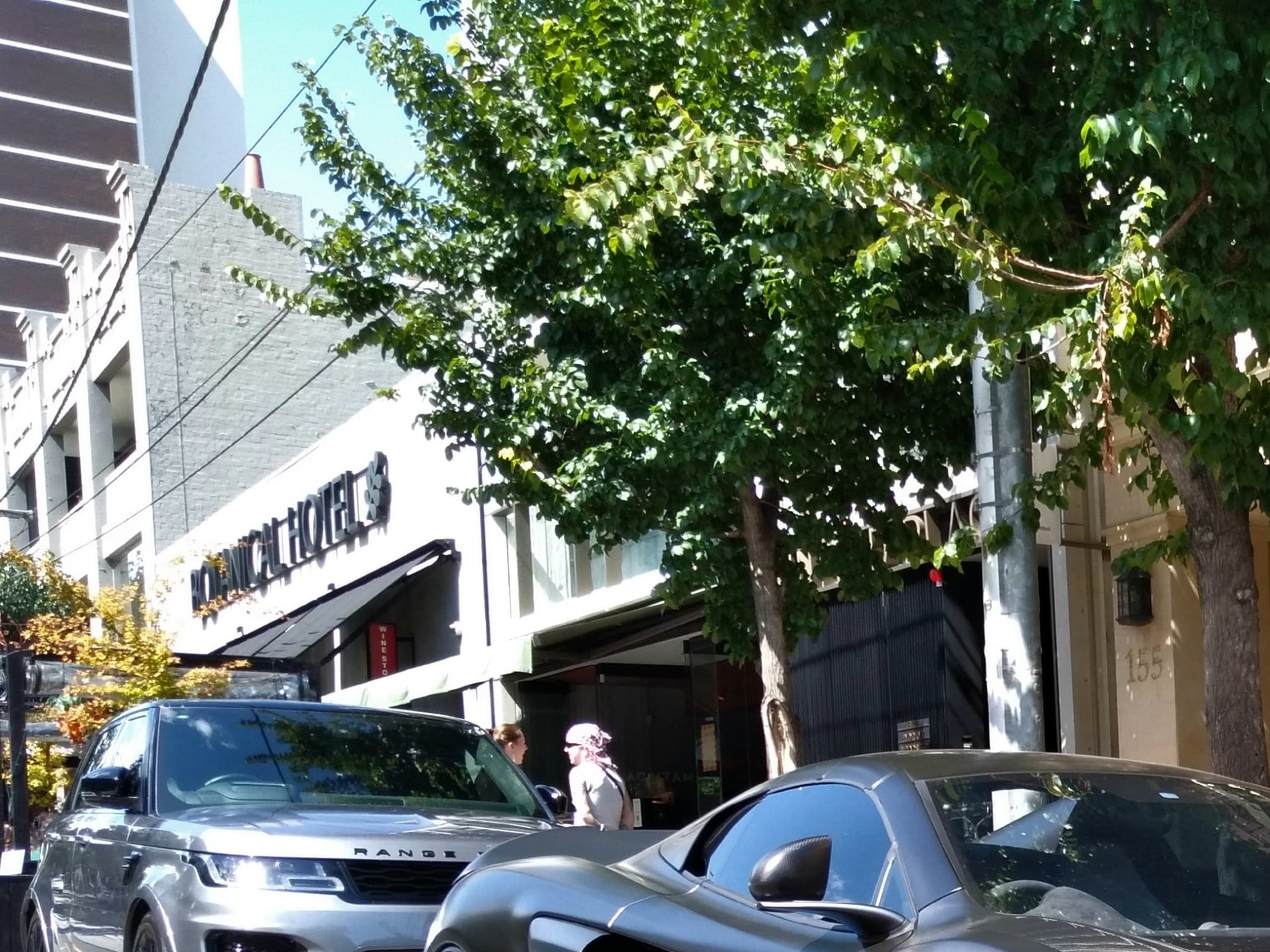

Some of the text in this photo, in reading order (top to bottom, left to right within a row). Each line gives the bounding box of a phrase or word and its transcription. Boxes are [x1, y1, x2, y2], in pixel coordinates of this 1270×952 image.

[190, 470, 364, 611] BOTANICAL HOTEL
[379, 626, 387, 653] WINE
[1124, 645, 1163, 683] 155
[354, 848, 457, 859] RANGE
